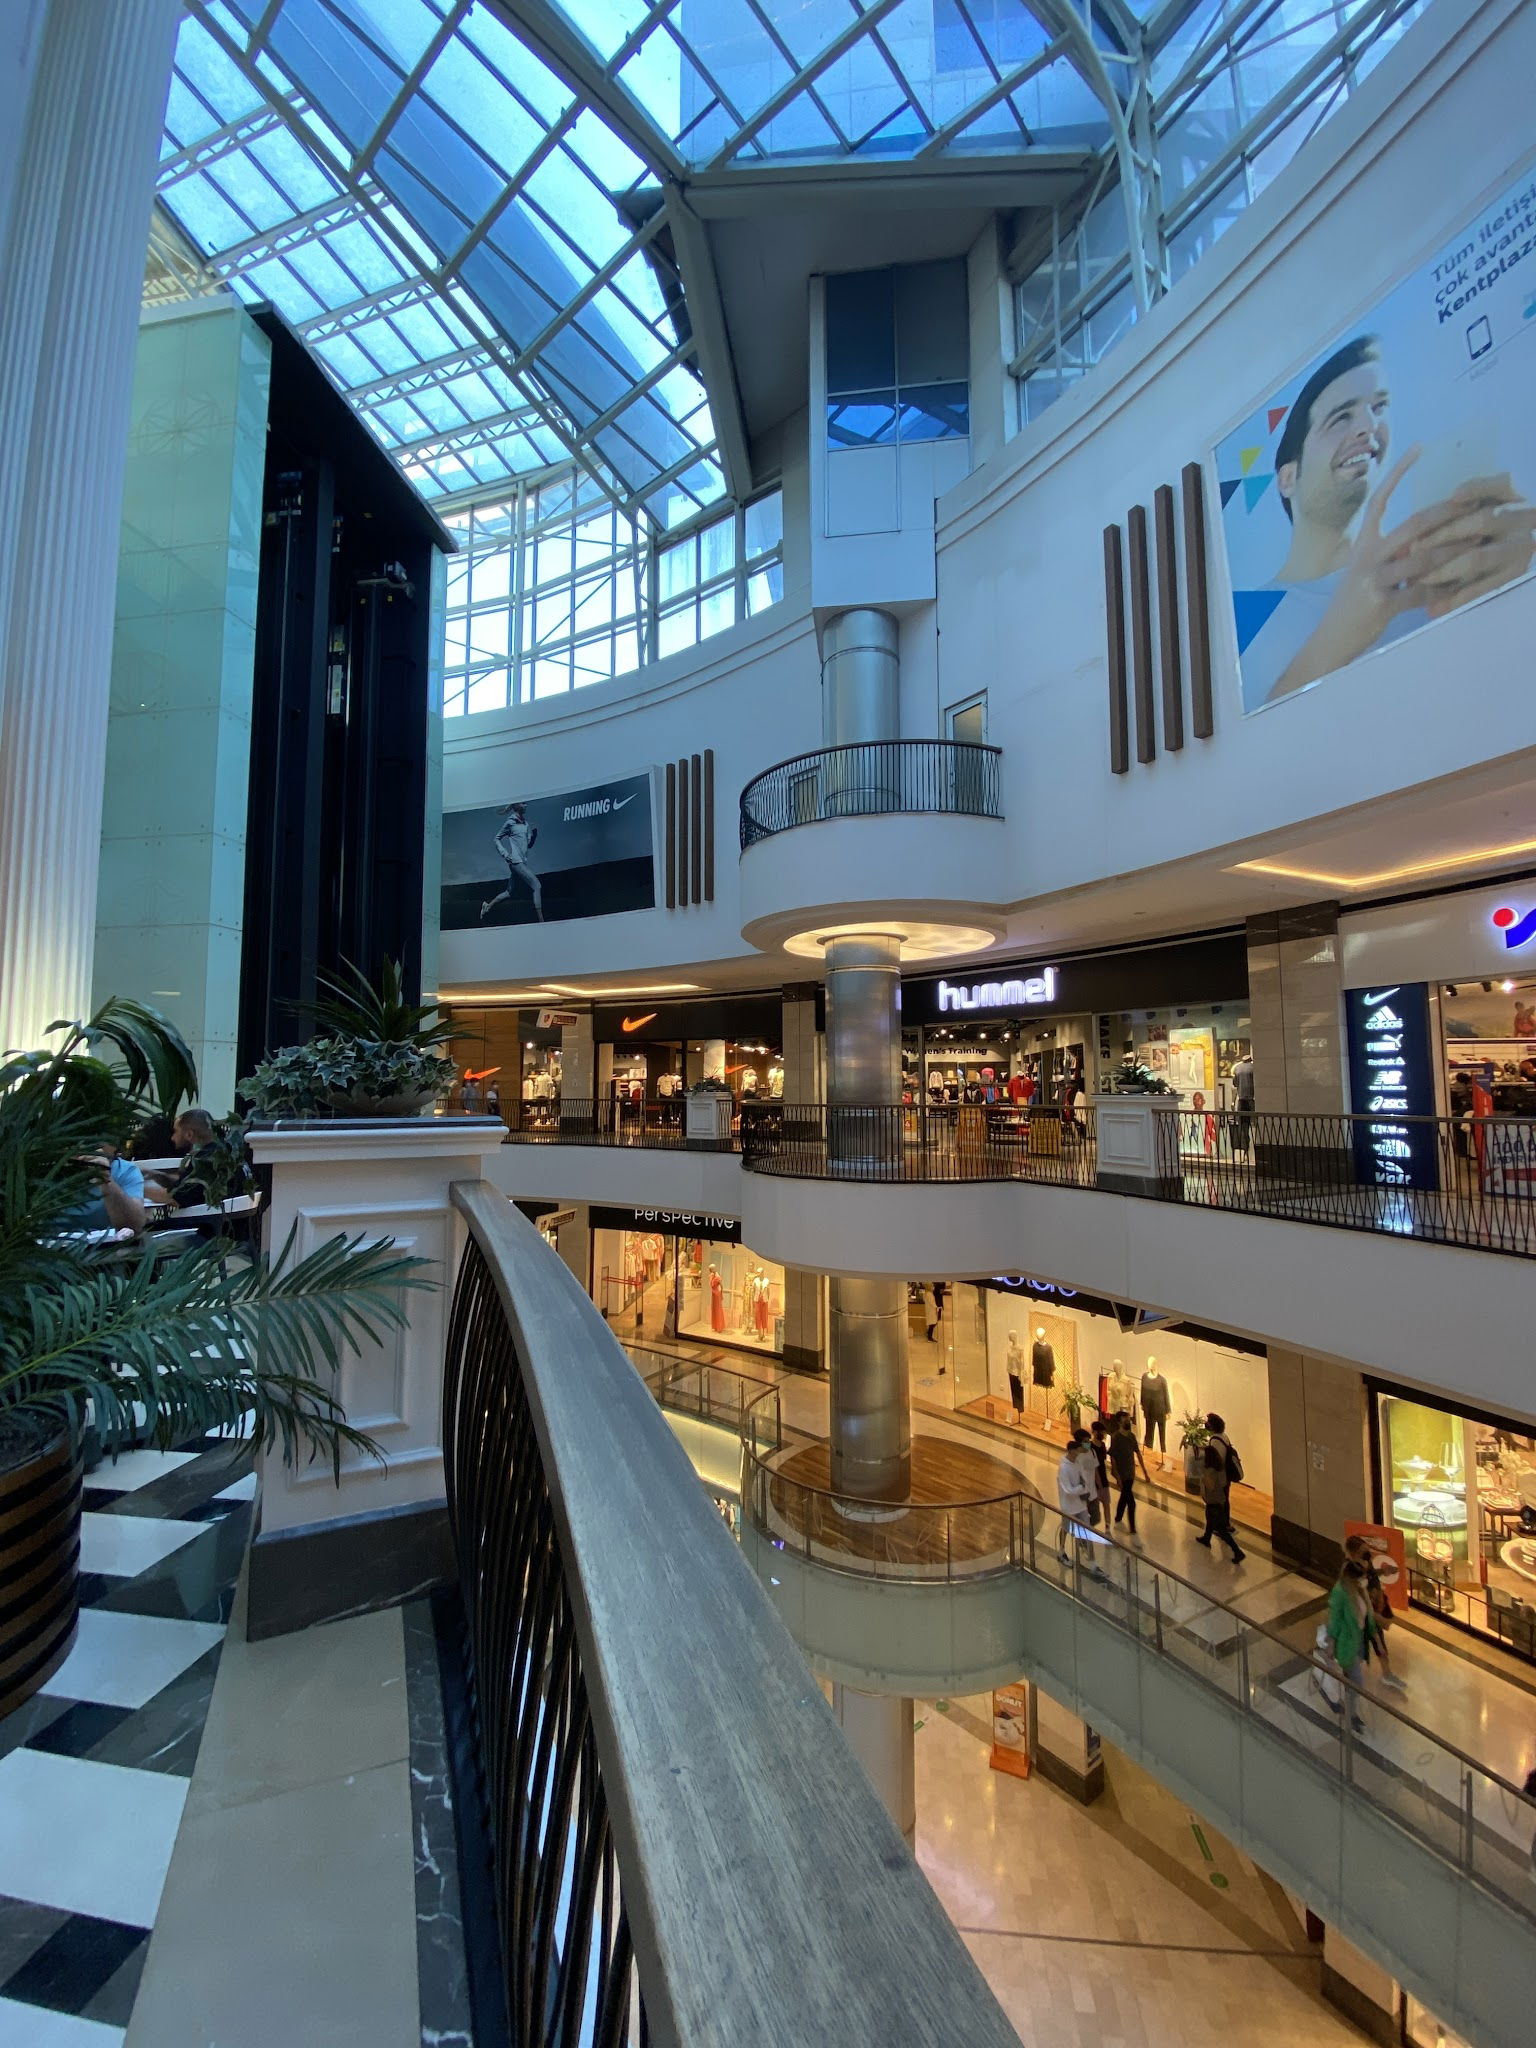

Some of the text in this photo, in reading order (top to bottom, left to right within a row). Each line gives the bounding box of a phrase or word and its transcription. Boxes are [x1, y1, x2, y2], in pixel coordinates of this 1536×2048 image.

[1430, 243, 1475, 282] Tüm
[1434, 210, 1536, 306] çok avant
[563, 798, 611, 821] RUNNING
[938, 966, 1055, 1012] hummel
[949, 1046, 988, 1056] Training
